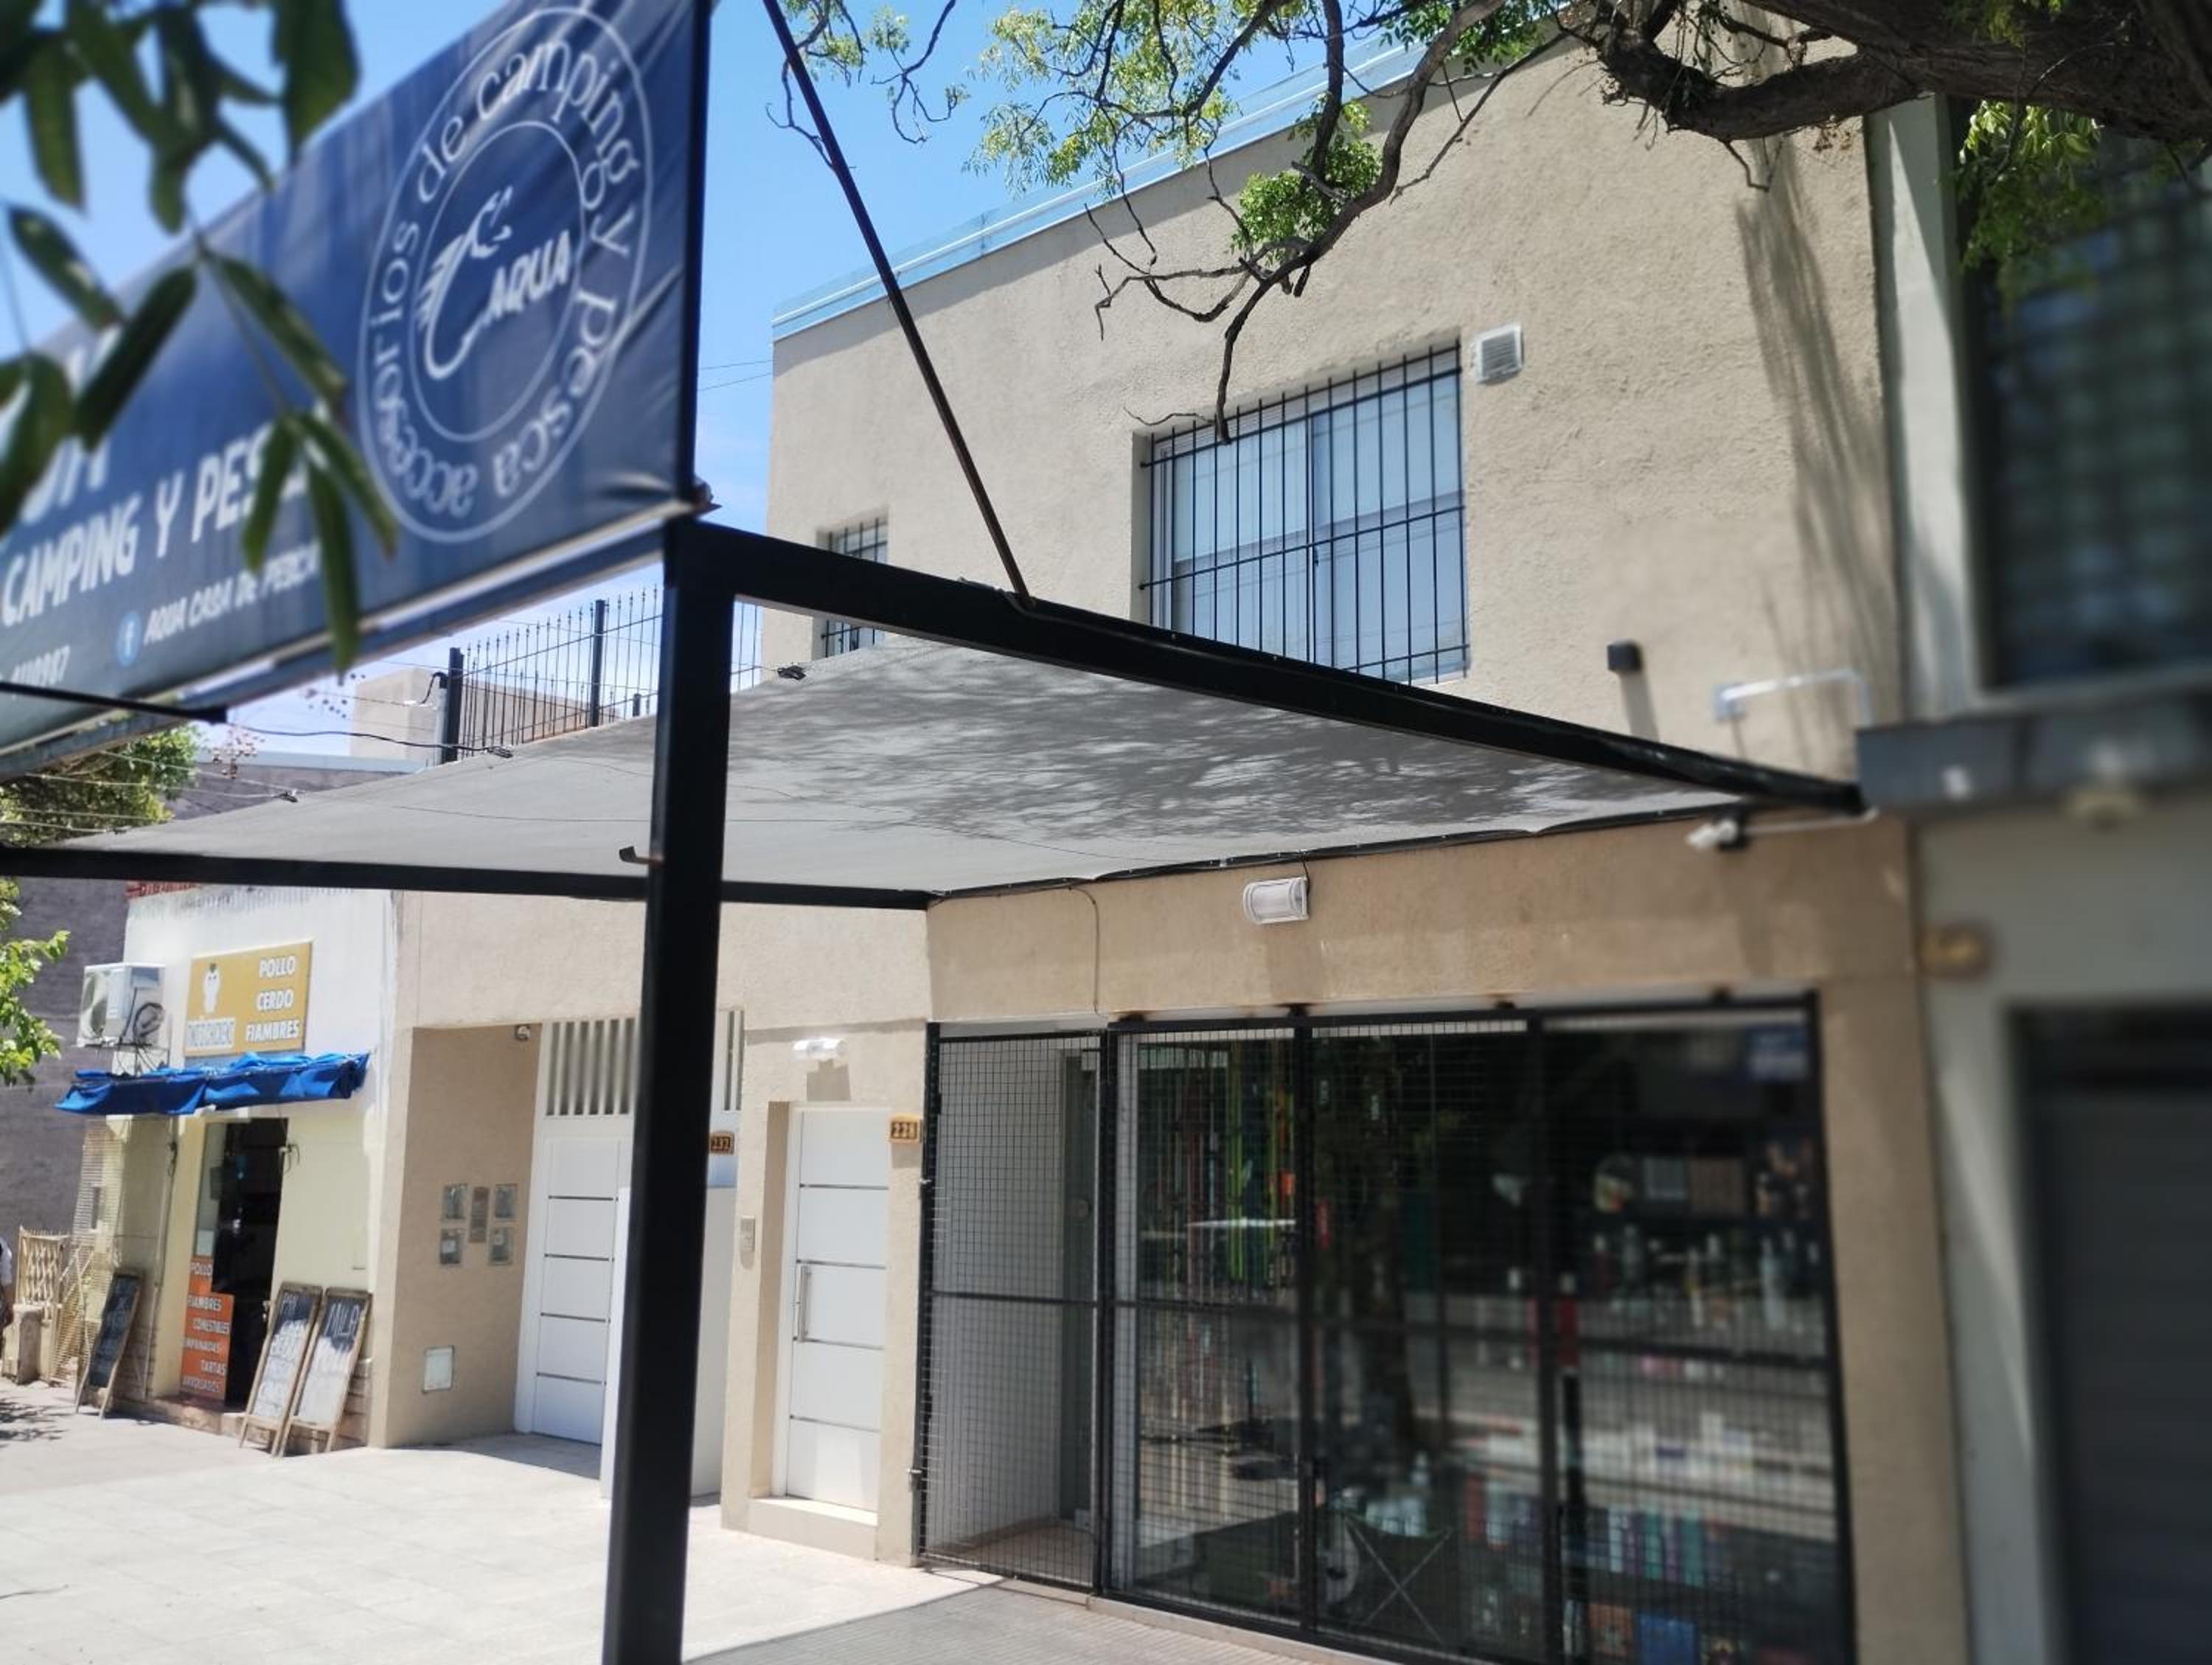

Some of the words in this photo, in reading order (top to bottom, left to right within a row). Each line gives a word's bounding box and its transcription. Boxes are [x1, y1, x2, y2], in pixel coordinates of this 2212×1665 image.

[418, 116, 467, 202] de
[477, 38, 639, 210] camping
[589, 205, 636, 259] y
[484, 229, 571, 322] AQUA
[493, 288, 616, 498] pesca
[1, 491, 143, 628] CAMPING
[155, 469, 185, 559] Y
[257, 989, 294, 1012] CERDO
[259, 955, 296, 979] POLLO
[246, 1020, 300, 1043] FIAMBRES
